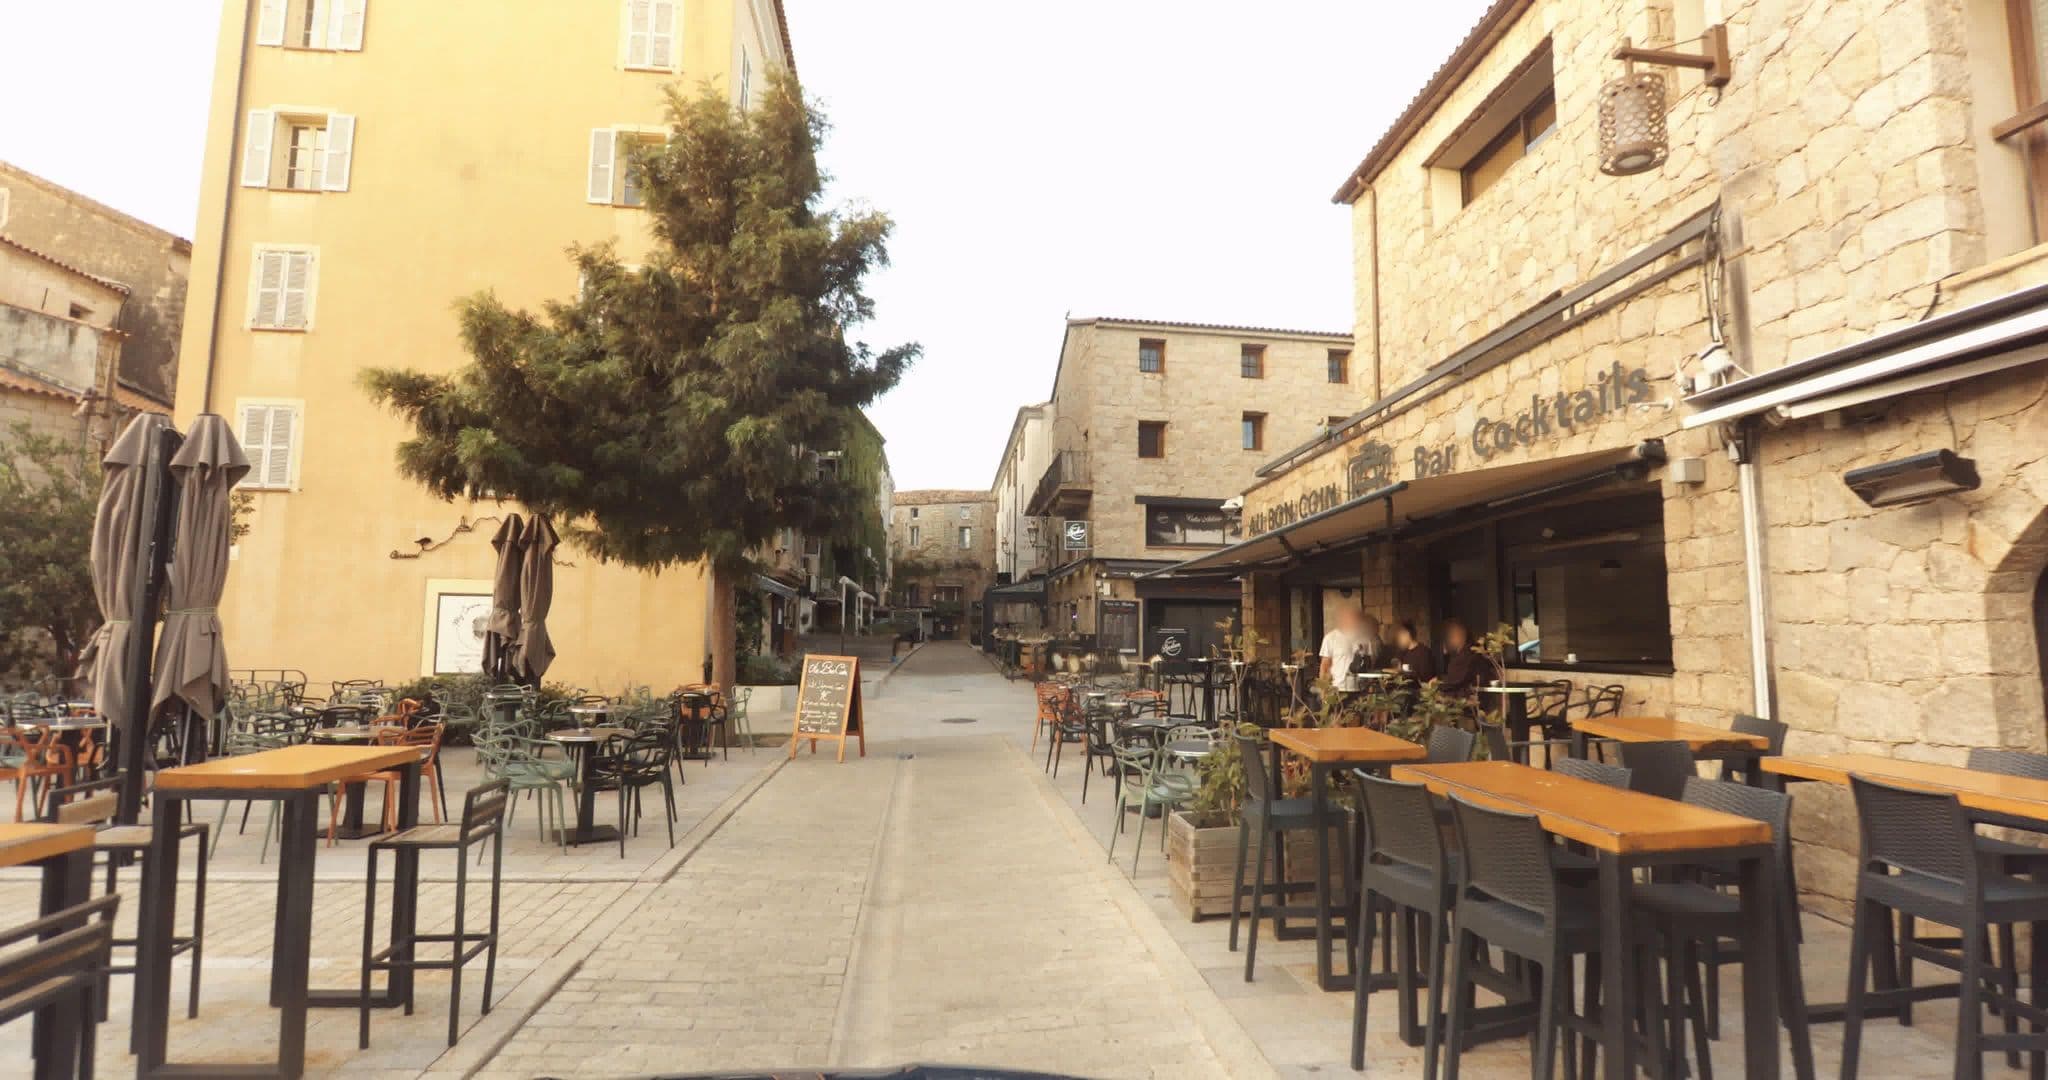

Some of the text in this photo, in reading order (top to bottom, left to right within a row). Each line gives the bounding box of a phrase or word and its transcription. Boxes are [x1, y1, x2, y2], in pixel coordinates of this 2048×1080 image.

[1413, 359, 1649, 479] Bar Cocktails
[1248, 483, 1337, 536] AU BON COIN
